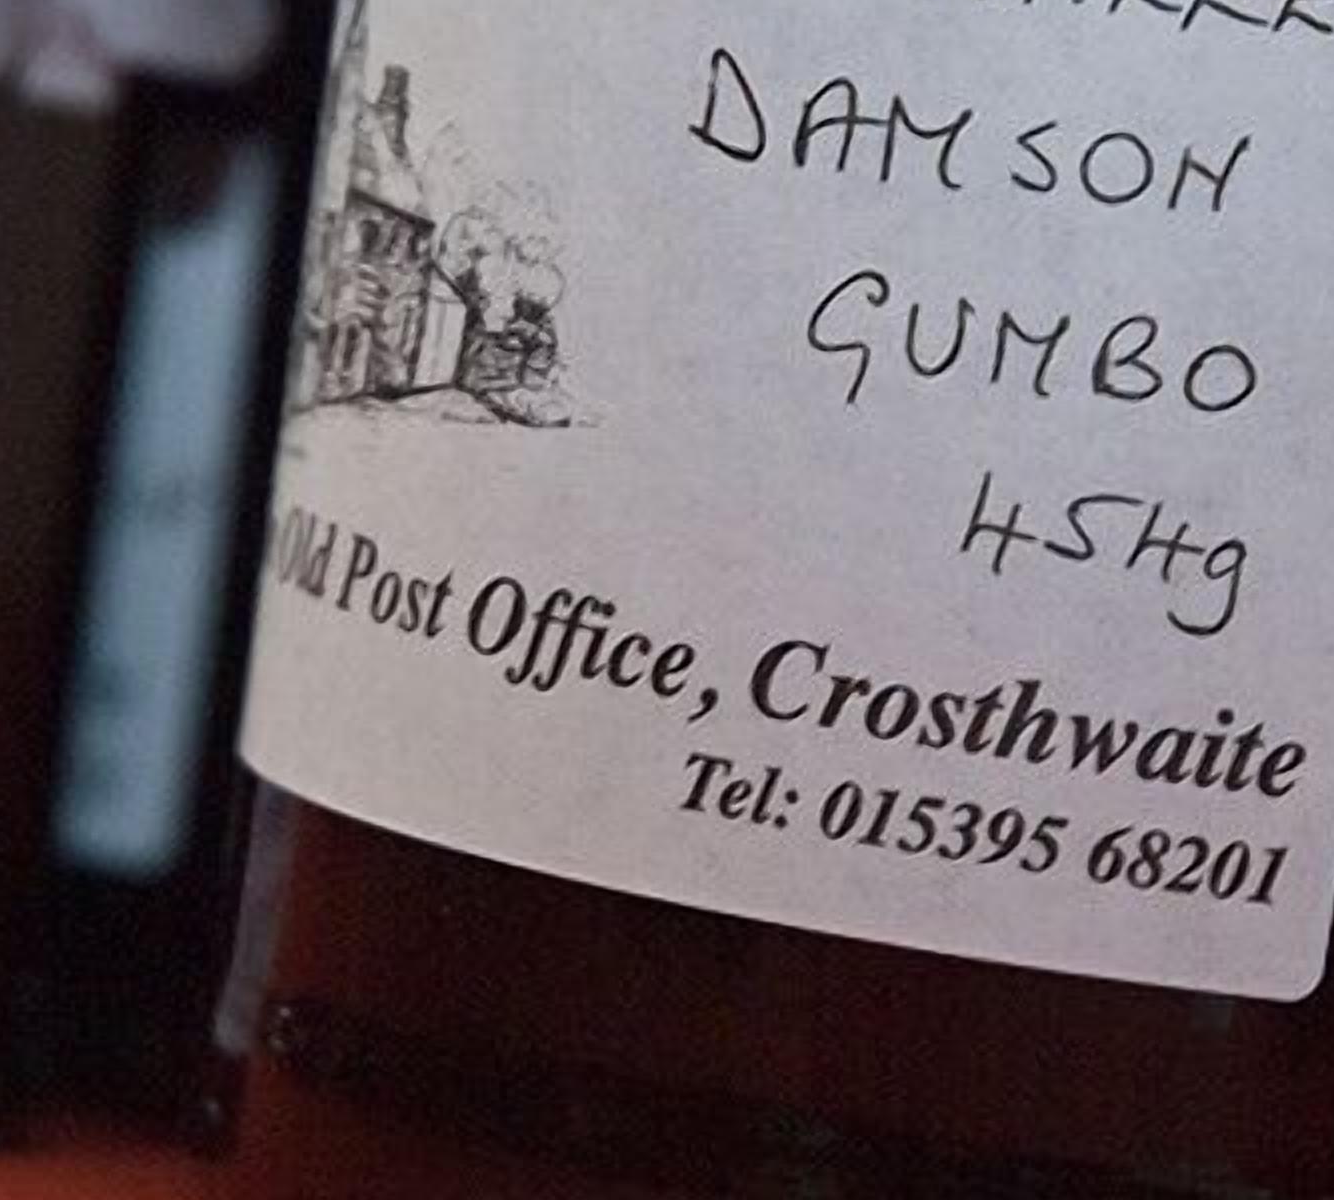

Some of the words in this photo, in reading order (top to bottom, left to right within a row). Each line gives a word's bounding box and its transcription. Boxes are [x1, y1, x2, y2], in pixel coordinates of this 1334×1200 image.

[688, 47, 1251, 211] DAMSON
[808, 272, 1258, 411] GUMBO
[959, 470, 1248, 635] 454g
[277, 505, 338, 598] Old
[335, 531, 456, 639] Post
[466, 574, 722, 721] Office,
[749, 636, 1309, 799] Crosthwaite
[681, 751, 791, 832] Tel:
[818, 779, 1069, 875] 015395
[1084, 823, 1290, 907] 68201
